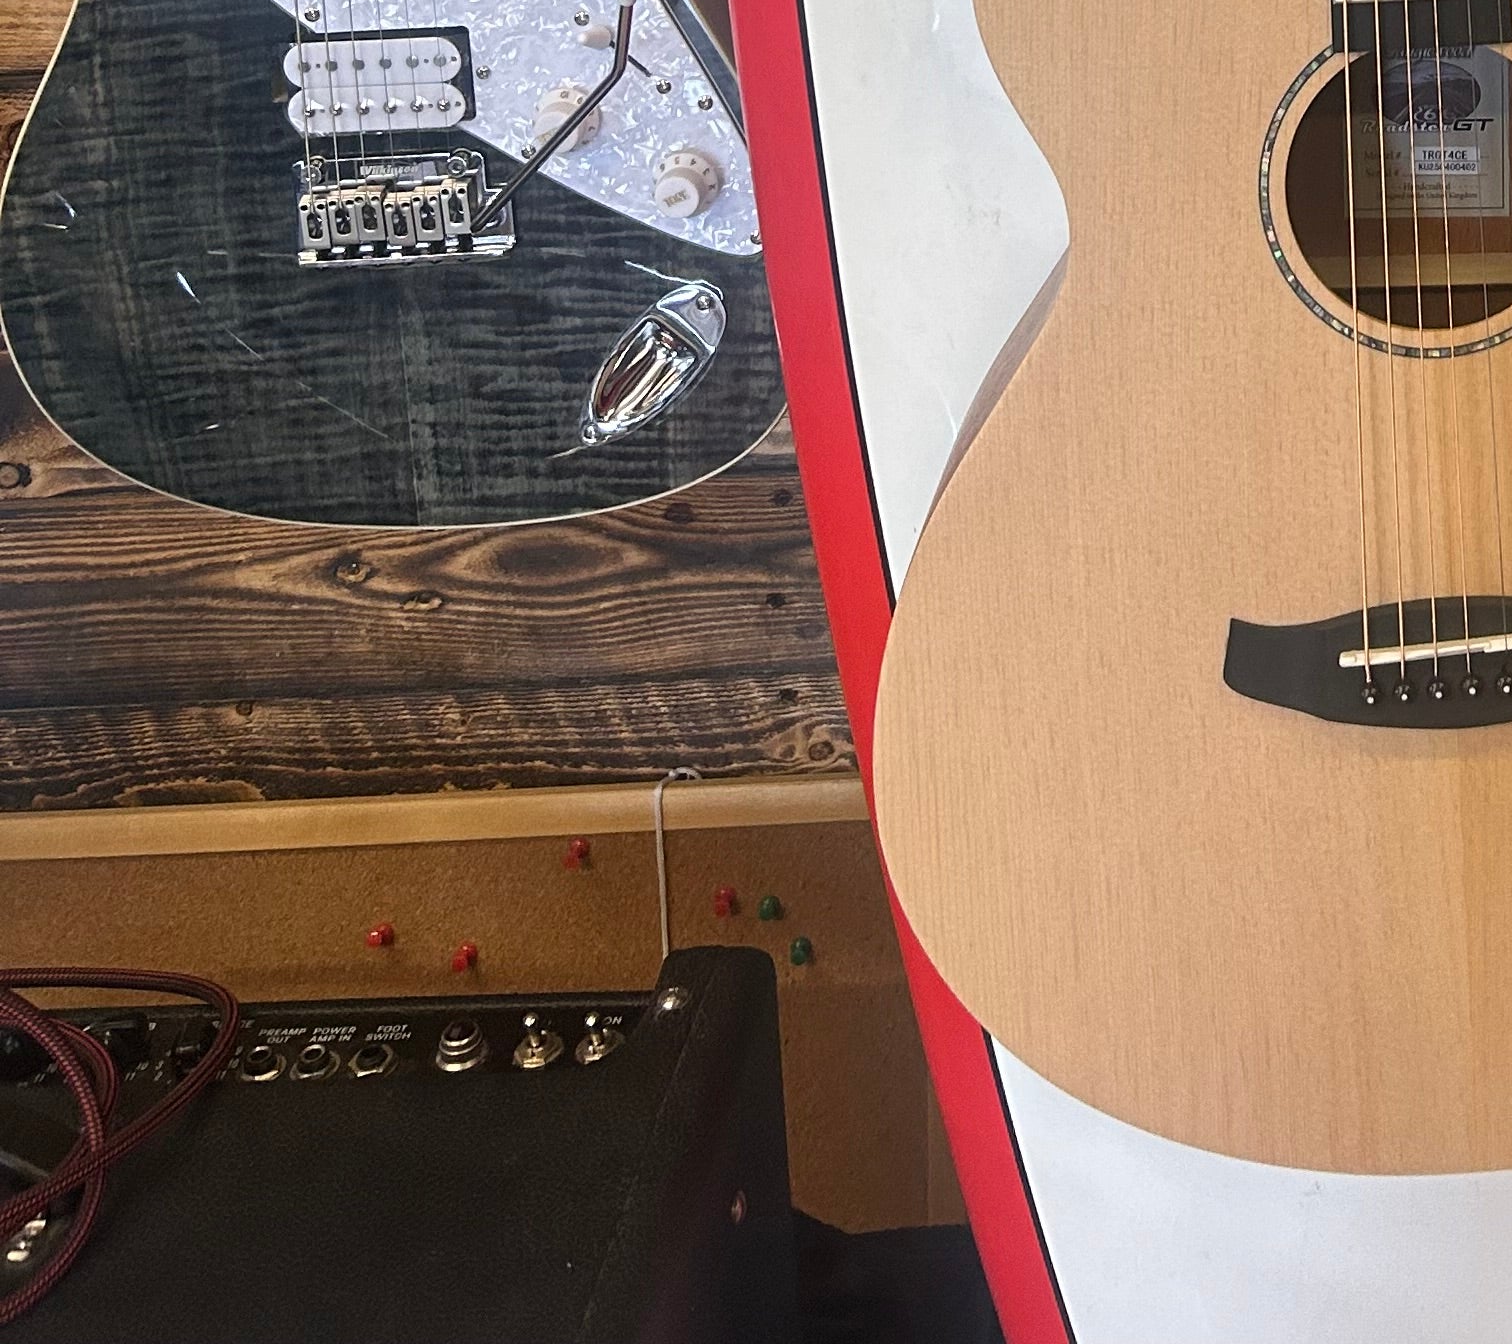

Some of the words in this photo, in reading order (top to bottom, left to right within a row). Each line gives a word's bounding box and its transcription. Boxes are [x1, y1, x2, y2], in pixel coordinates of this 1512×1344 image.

[1453, 118, 1495, 132] GT
[258, 1027, 307, 1037] PREAMP
[313, 1025, 357, 1035] POWER
[377, 1024, 408, 1033] FOOT
[267, 1036, 290, 1044] OUT
[309, 1034, 336, 1043] AMP
[338, 1034, 352, 1042] IN
[365, 1032, 411, 1041] SWITCH
